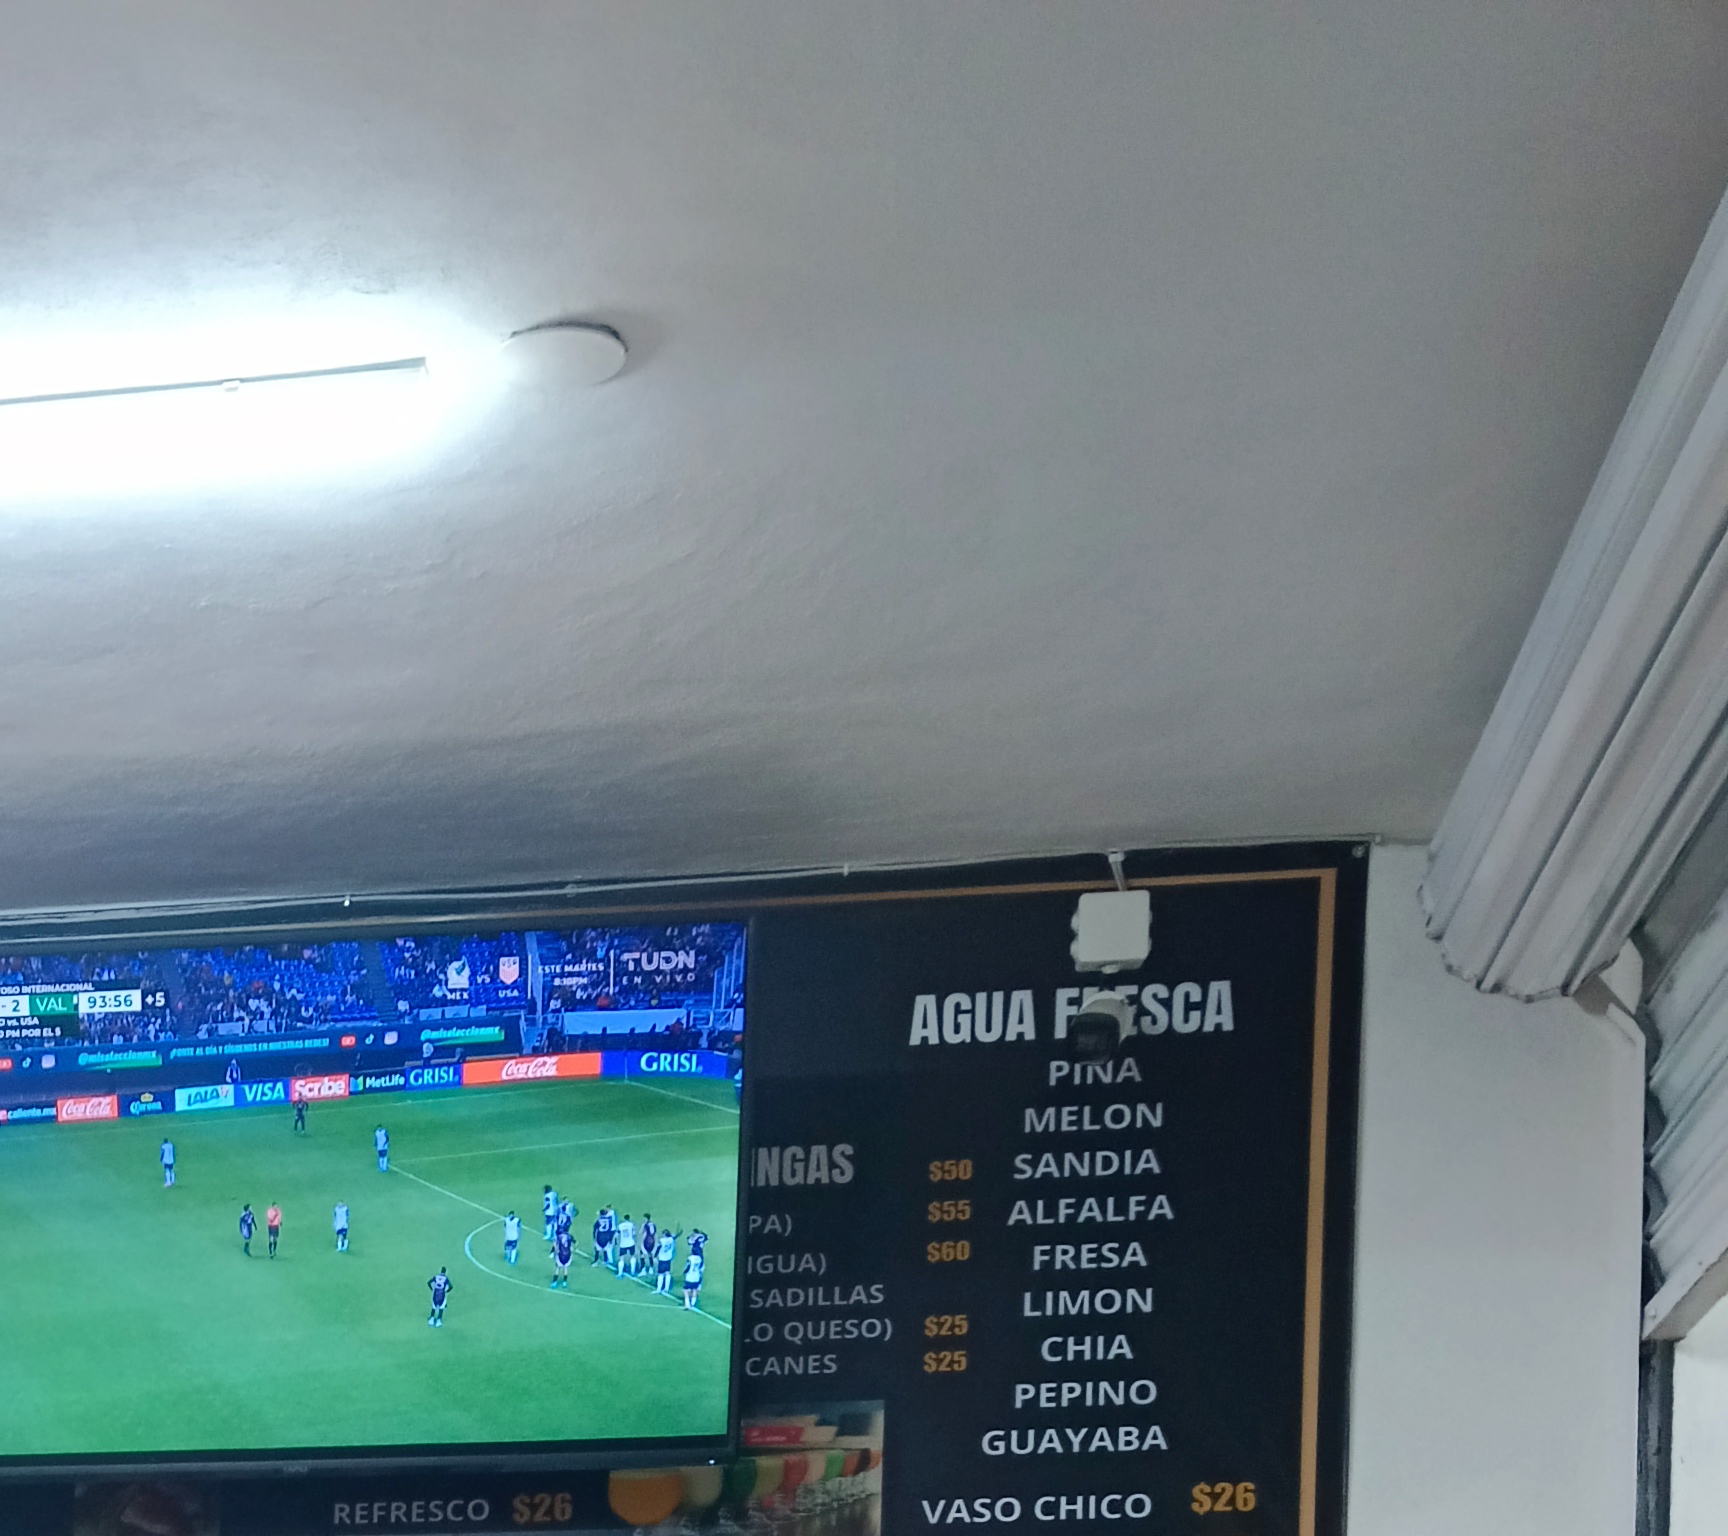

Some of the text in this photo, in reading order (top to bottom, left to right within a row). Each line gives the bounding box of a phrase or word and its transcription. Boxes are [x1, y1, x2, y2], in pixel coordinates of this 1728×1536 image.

[622, 950, 695, 971] TUDN
[21, 982, 95, 994] INTERNACIONAL
[622, 973, 696, 985] EN VIVO
[11, 1000, 21, 1013] 2
[35, 997, 67, 1012] VAL
[87, 993, 165, 1009] 93:56 +5
[498, 989, 519, 997] USA
[20, 1017, 39, 1027] USA
[908, 989, 1036, 1046] AGUA
[5, 1029, 20, 1039] PM
[21, 1028, 41, 1038] POR
[42, 1027, 54, 1037] EL
[640, 1052, 698, 1073] GRISI
[365, 1072, 406, 1089] MetLife
[409, 1065, 454, 1086] GRISI
[243, 1081, 285, 1102] VISA
[294, 1077, 345, 1099] Scribe
[1022, 1101, 1165, 1135] MELON
[928, 1158, 973, 1183] $50
[1012, 1148, 1163, 1180] SANDIA
[927, 1200, 971, 1223] $55
[1007, 1193, 1175, 1227] ALFALFA
[926, 1240, 970, 1264] $60
[1031, 1240, 1148, 1272] FRESA
[1022, 1287, 1155, 1318] LIMON
[783, 1317, 894, 1345] QUESO)
[924, 1314, 969, 1338] $25
[1039, 1333, 1135, 1364] CHIA
[923, 1351, 968, 1374] $25
[1012, 1377, 1159, 1410] PEPINO
[980, 1424, 1169, 1457] GUAYABA
[512, 1492, 572, 1525] $26
[921, 1492, 1154, 1525] VASO CHICO
[1190, 1481, 1257, 1515] $26
[333, 1499, 490, 1525] REFRESCO
